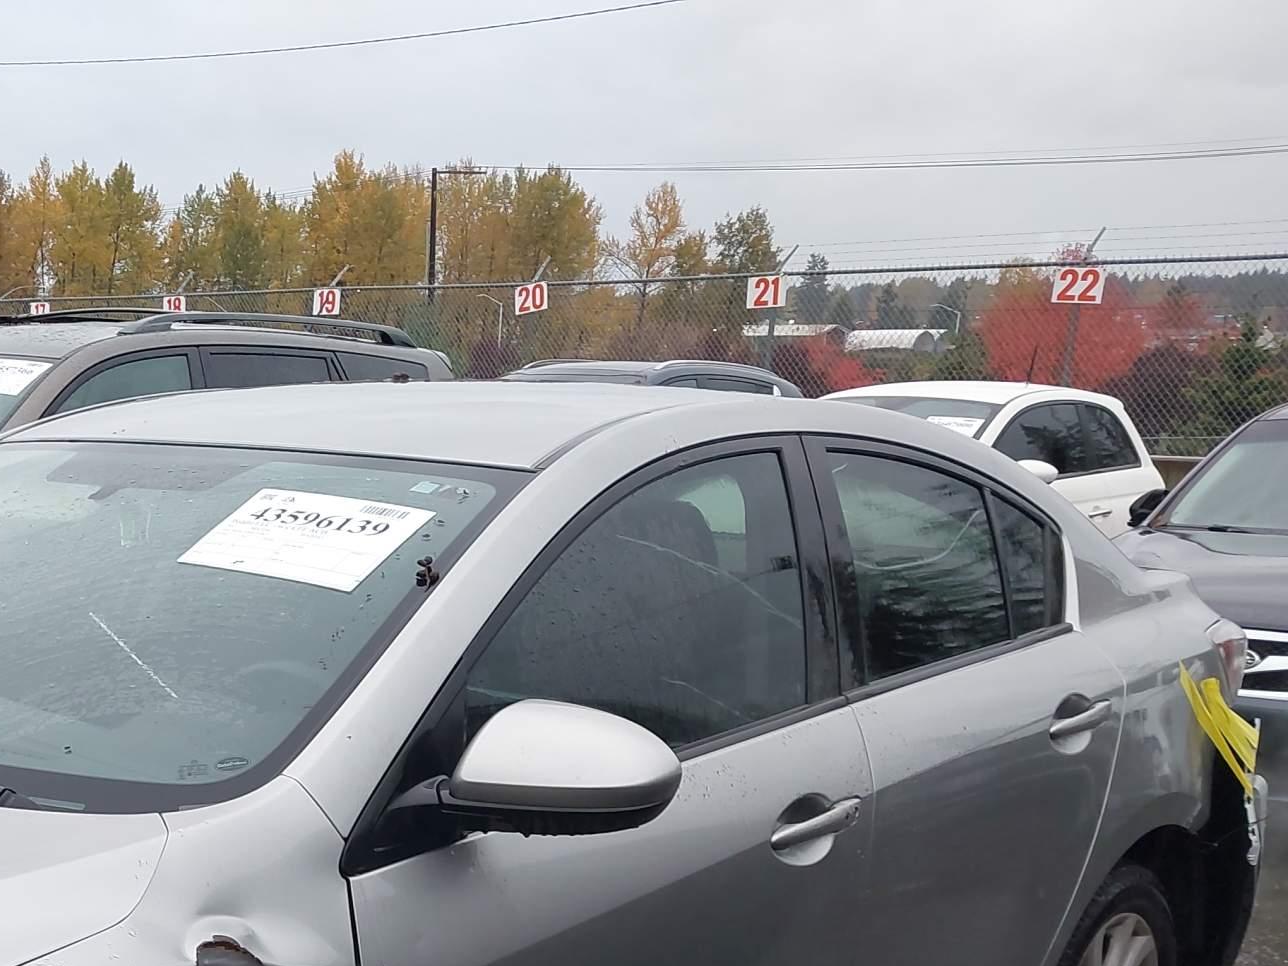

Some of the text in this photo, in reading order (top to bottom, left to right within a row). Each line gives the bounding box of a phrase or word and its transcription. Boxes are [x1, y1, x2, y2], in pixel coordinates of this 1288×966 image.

[517, 282, 546, 313] 20
[753, 276, 781, 307] 21
[1056, 267, 1101, 303] 22
[318, 289, 336, 314] 19
[250, 506, 391, 536] 43596139
